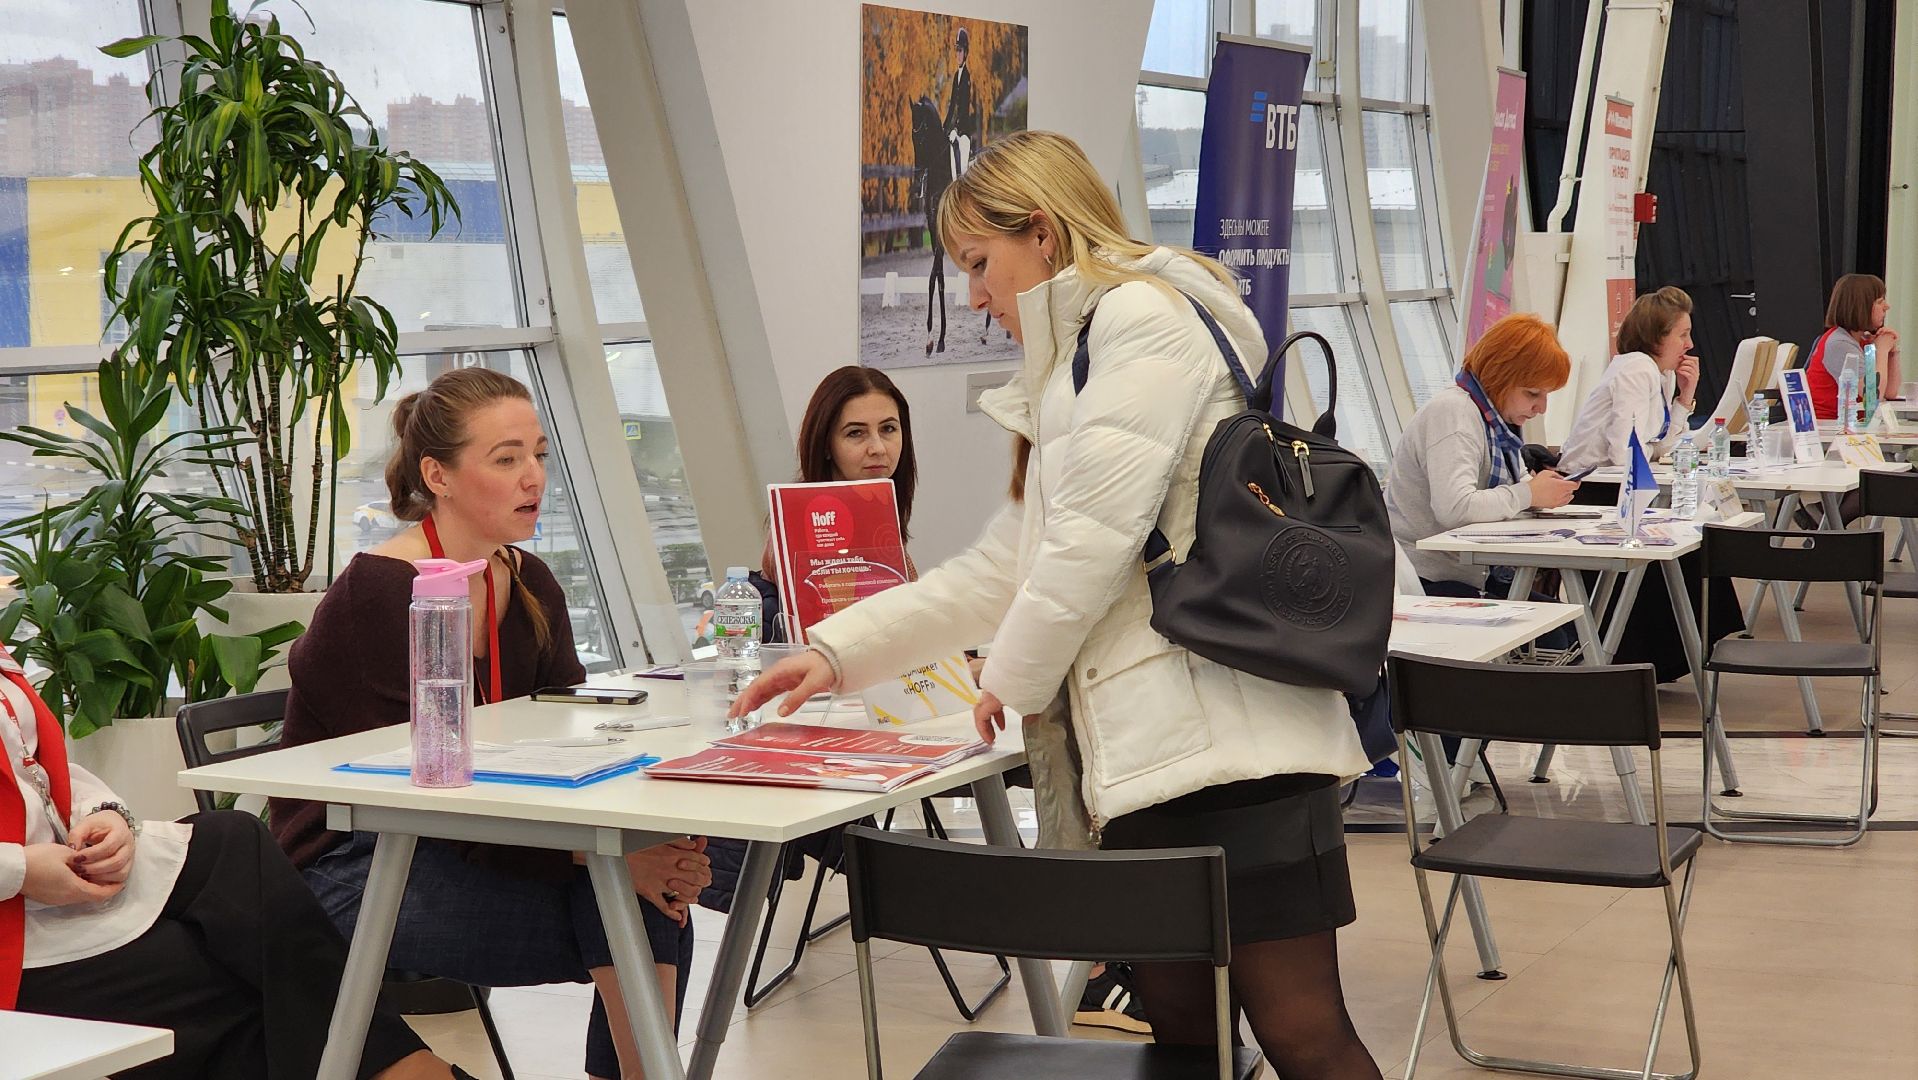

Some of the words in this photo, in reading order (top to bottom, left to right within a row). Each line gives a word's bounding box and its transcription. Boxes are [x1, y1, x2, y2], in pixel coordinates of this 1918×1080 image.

[1265, 103, 1297, 151] ВТБ
[1244, 219, 1270, 236] МОЖЕТЕ
[1218, 248, 1255, 267] ОФОРМИТЬ
[811, 511, 836, 526] Hoff
[810, 558, 824, 566] Мы
